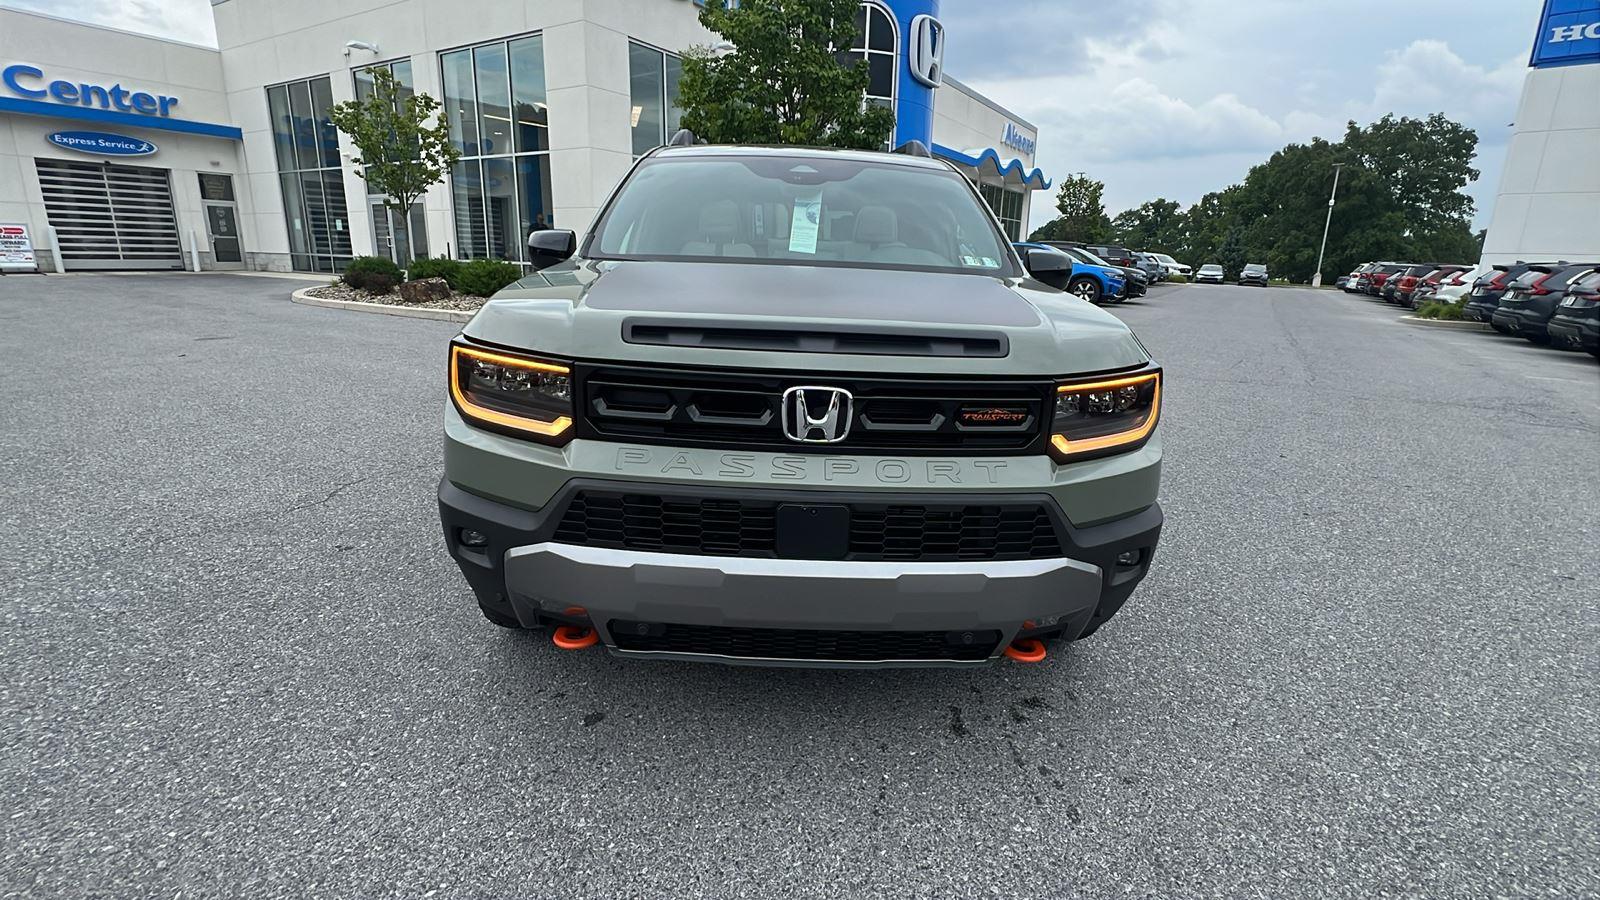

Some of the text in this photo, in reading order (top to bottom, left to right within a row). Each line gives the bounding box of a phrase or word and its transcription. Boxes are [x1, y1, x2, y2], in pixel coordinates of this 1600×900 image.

[2, 64, 179, 117] Center
[54, 134, 136, 150] Express Service
[962, 413, 1026, 421] TRAILSPORT
[614, 447, 1009, 484] PASSPORT
